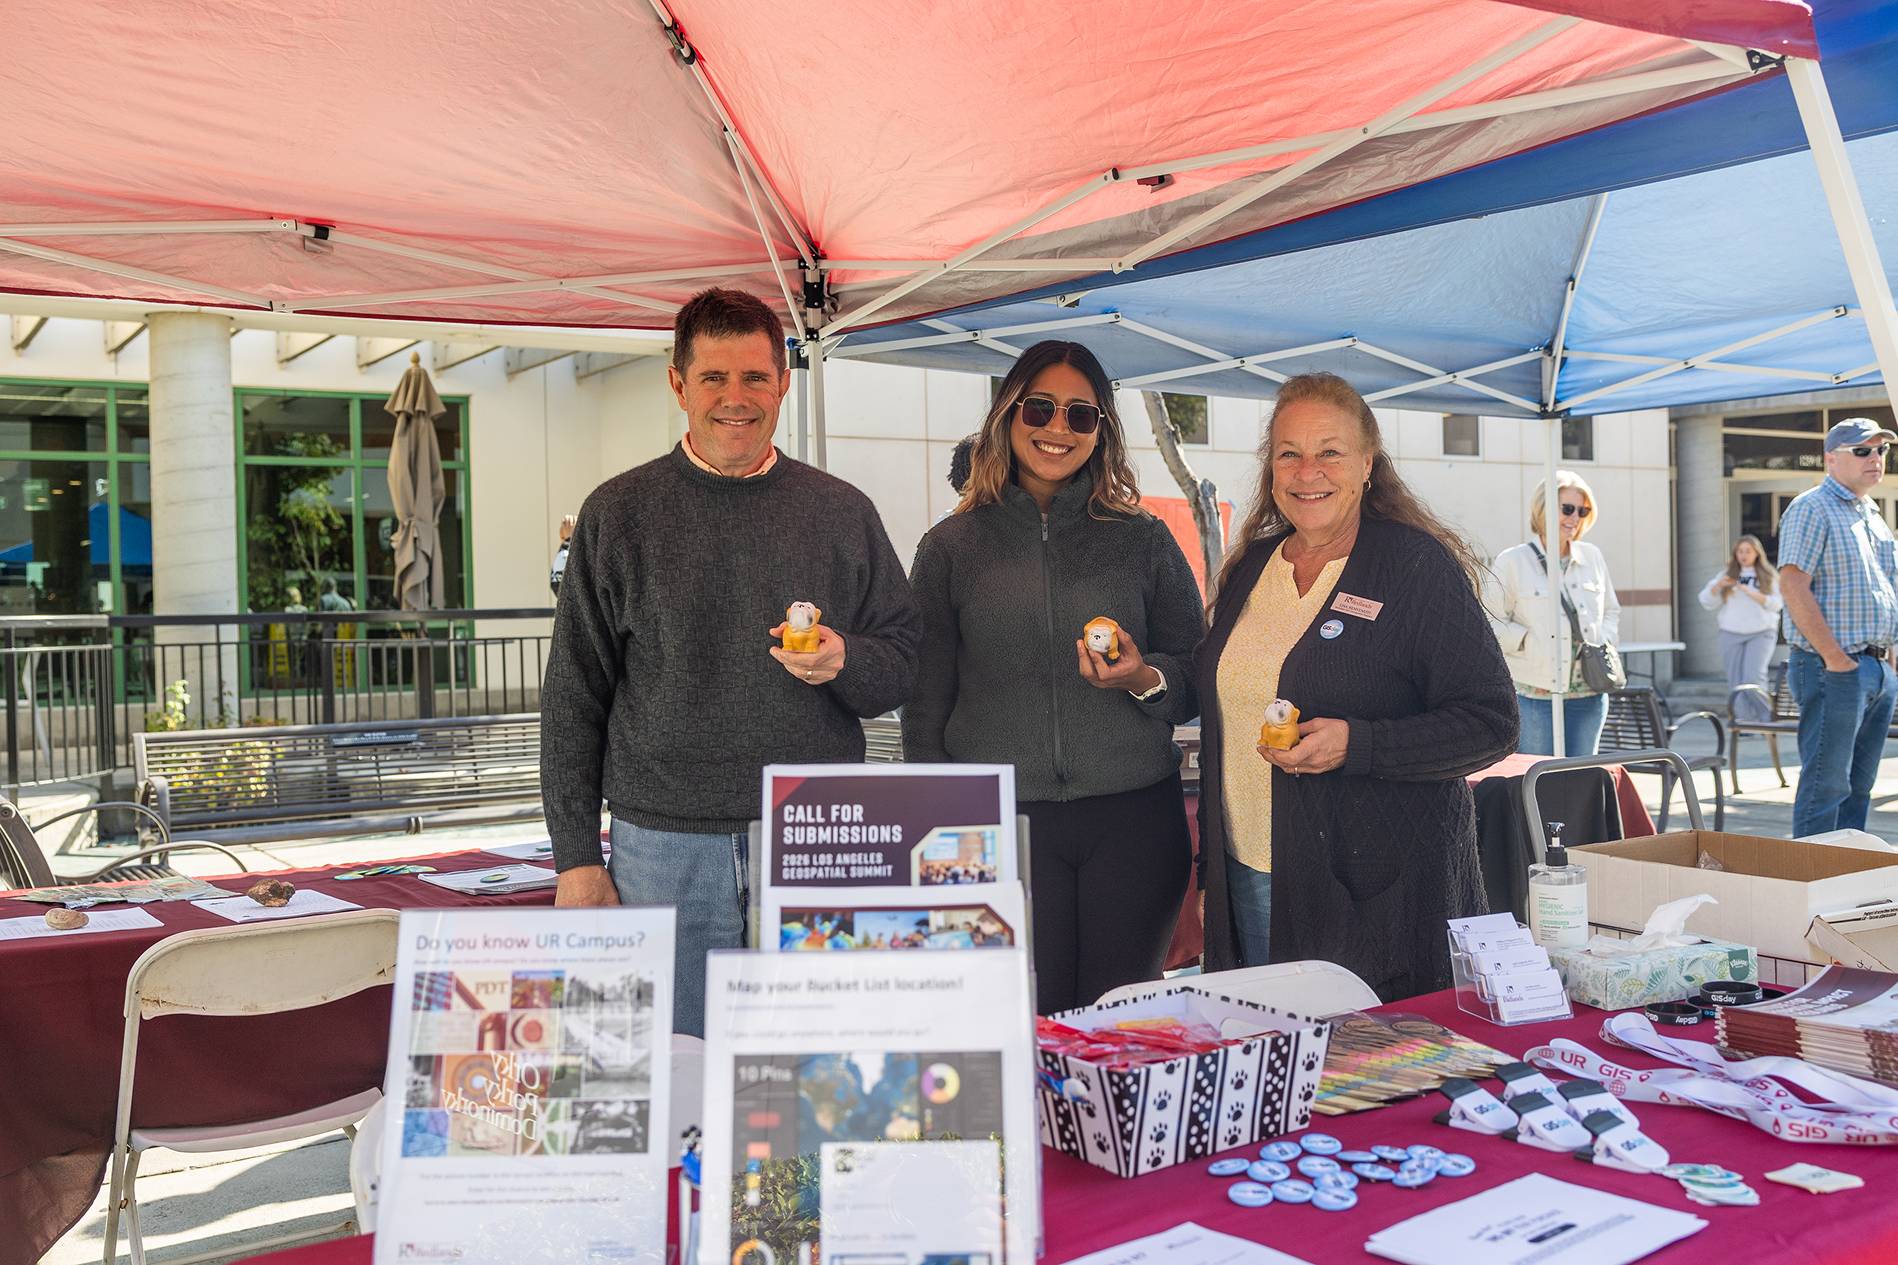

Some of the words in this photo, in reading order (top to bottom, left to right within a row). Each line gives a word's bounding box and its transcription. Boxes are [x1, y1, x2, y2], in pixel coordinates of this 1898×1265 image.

[783, 804, 826, 823] CALL
[830, 803, 864, 823] FOR
[783, 824, 903, 844] SUBMISSIONS
[812, 853, 834, 866] LOS
[835, 851, 884, 866] ANGELES
[782, 865, 848, 880] GEOSPATIAL
[849, 864, 893, 878] SUMMIT
[415, 934, 440, 951] Do
[445, 937, 477, 953] you
[482, 934, 530, 949] know
[535, 933, 560, 948] UR
[566, 931, 646, 952] Campus?
[475, 981, 509, 996] PDT
[726, 980, 761, 995] Map
[767, 981, 802, 995] your
[807, 979, 860, 993] Bucket
[864, 979, 891, 992] List
[895, 978, 964, 992] location!
[1710, 994, 1737, 1004] GISday
[737, 1066, 759, 1083] 10
[761, 1065, 793, 1082] Pins
[1560, 1050, 1588, 1069] UR
[1598, 1063, 1633, 1082] GIS
[1787, 1121, 1829, 1140] GIS
